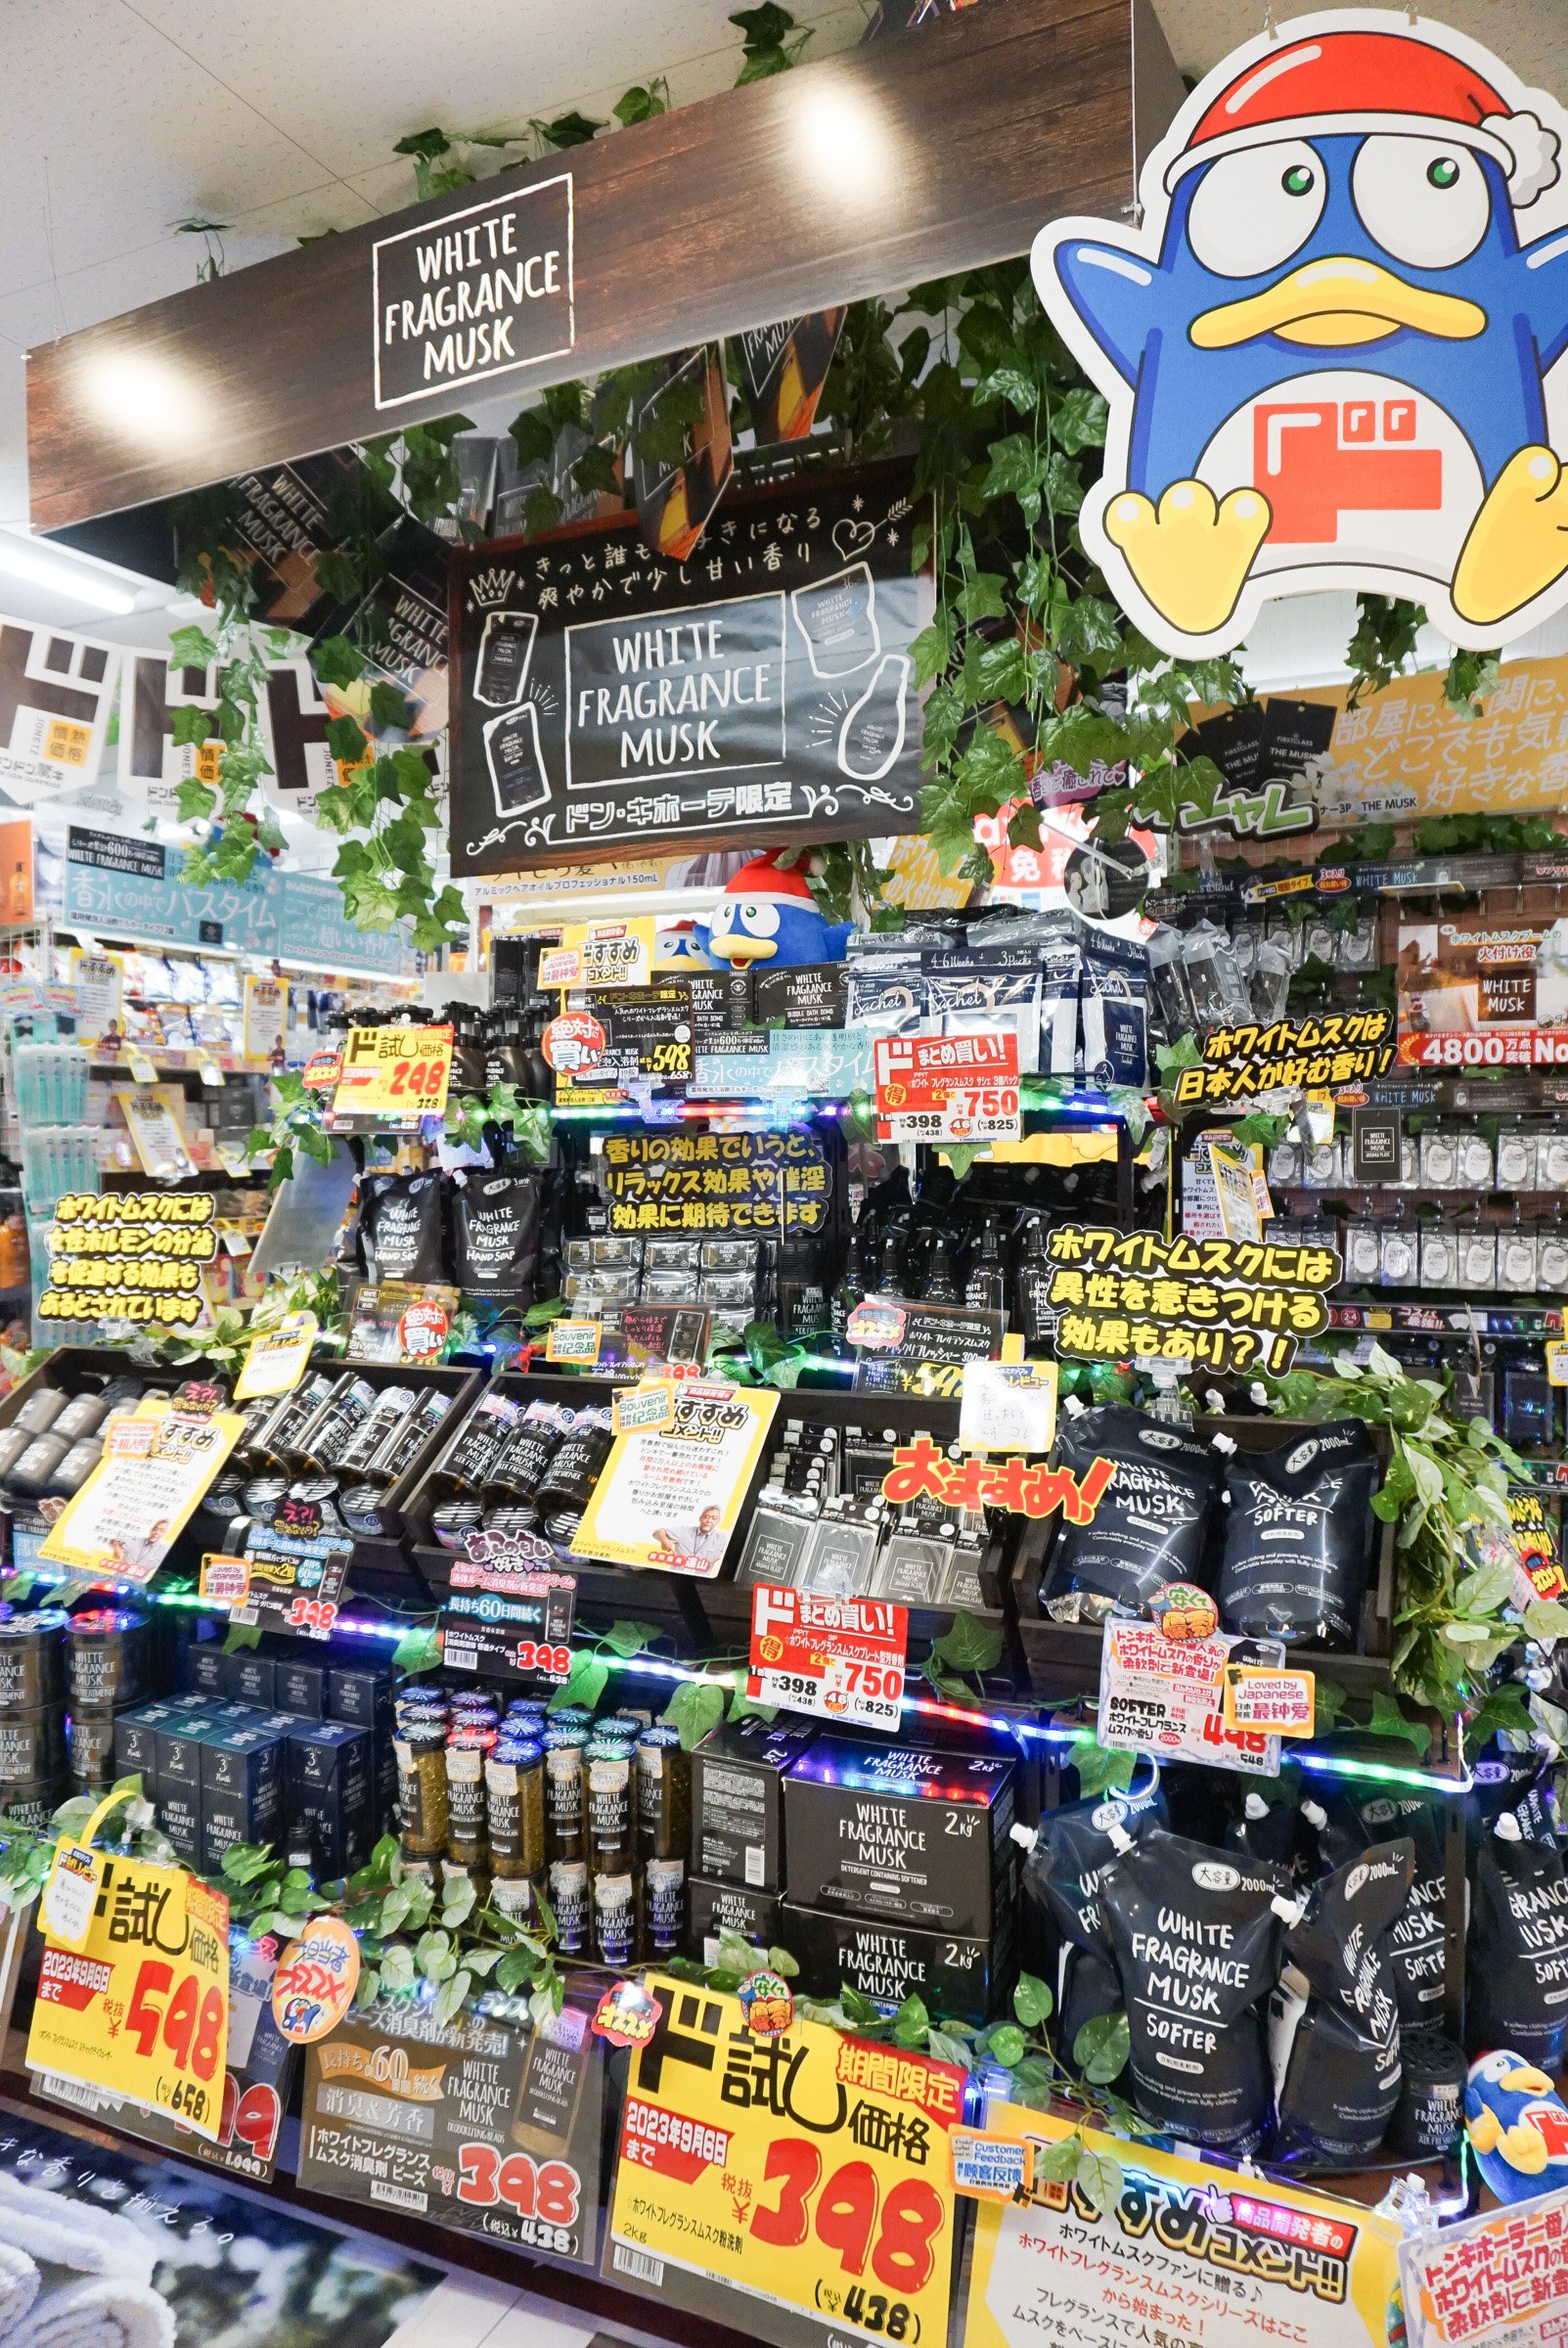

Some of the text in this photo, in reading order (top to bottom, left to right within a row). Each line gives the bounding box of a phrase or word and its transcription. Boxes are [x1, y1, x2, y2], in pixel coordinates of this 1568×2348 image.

[417, 213, 517, 283] WHITE
[385, 250, 560, 344] FRAGRANCE
[424, 316, 515, 380] MUSK
[271, 474, 324, 531] WHITE
[237, 509, 289, 563] MUSK
[538, 543, 810, 609] 爽やかで少し甘い香り
[613, 619, 724, 673] WHITE
[578, 664, 771, 727] FRAGRANCE
[621, 720, 721, 768] MUSK
[565, 782, 792, 834] ドン・キホーテ限定
[1356, 872, 1418, 887] WHITE MUSK
[1450, 928, 1562, 946] ホワイトムスクブームの
[786, 982, 832, 995] FRAGRANCE
[795, 972, 822, 983] WHITE
[1482, 978, 1531, 994] WHITE
[797, 993, 823, 1005] MUSK
[854, 989, 901, 1016] Sachet
[930, 988, 982, 1013] Sachet
[1488, 997, 1525, 1012] MUSK
[1207, 1014, 1386, 1059] ホワイトムスクは
[652, 1044, 691, 1072] 598
[918, 1034, 1007, 1066] まとめ買い!
[1422, 1038, 1504, 1064] 4800
[389, 1061, 447, 1096] 298
[1179, 1048, 1396, 1102] 日本人が好む香り!
[963, 1090, 1018, 1116] 750
[605, 1133, 817, 1164] 香りの効果でいうと、
[606, 1166, 826, 1196] リラックス効果や催淫
[57, 1196, 212, 1222] ホワイトムスクには
[476, 1206, 514, 1221] WHITE
[612, 1202, 822, 1230] 効果に期待できます
[469, 1219, 520, 1236] FRAGRANCE
[49, 1226, 214, 1256] 女性ホルモンの分泌
[476, 1236, 509, 1246] MUSK
[1051, 1229, 1332, 1282] ホワイトムスクには
[50, 1259, 199, 1288] を促進する効果も
[40, 1290, 202, 1323] あるとされています
[1051, 1271, 1321, 1330] 異性を惹きつける
[554, 1332, 596, 1342] Souvenir
[619, 1394, 667, 1412] Souvenir
[507, 1444, 548, 1468] FRAGRANCE
[518, 1437, 545, 1454] WHITE
[560, 1443, 585, 1453] WHITE
[510, 1454, 537, 1469] MUSK
[628, 1480, 711, 1497] ホワイトフレグランスムスクの
[882, 1436, 1115, 1526] おすすめ!
[631, 1498, 695, 1513] 包み込み至福の時間
[632, 1489, 700, 1505] 香りがお部屋をやさしく
[1115, 1494, 1185, 1515] MUSK
[641, 1508, 679, 1518] へと誘います
[1254, 1507, 1319, 1526] SOFTER
[291, 1598, 337, 1631] 398
[449, 1597, 541, 1622] 長持ち60日間続く
[800, 1603, 894, 1635] まとめ買い!
[75, 1651, 104, 1665] WHITE
[517, 1641, 571, 1675] 398
[75, 1674, 105, 1687] MUSK
[844, 1661, 903, 1701] 750
[1248, 1681, 1297, 1692] Loved by
[1110, 1695, 1166, 1718] SOFTER
[1238, 1690, 1304, 1700] Japanese
[1108, 1713, 1187, 1733] ホワイトフレグランス
[1253, 1703, 1310, 1721] 最钟爱
[1108, 1725, 1153, 1740] ムスクの香り
[864, 1756, 943, 1776] FRAGRANCE
[887, 1750, 932, 1764] WHITE
[447, 1792, 483, 1804] FRAGRANCE
[452, 1783, 475, 1792] WHITE
[596, 1793, 619, 1804] WHITE
[168, 1801, 188, 1815] WHITE
[589, 1802, 628, 1815] FRAGRANCE
[597, 1814, 619, 1826] MUSK
[856, 1803, 907, 1829] WHITE
[161, 1813, 195, 1830] FRAGRANCE
[169, 1825, 188, 1838] MUSK
[839, 1820, 927, 1852] FRAGRANCE
[859, 1843, 907, 1870] MUSK
[840, 1865, 927, 1886] DETERGENT CONTAINING SOFTENER
[1198, 1866, 1234, 1887] 大容量
[712, 1902, 756, 1920] FRAGRANCE
[721, 1893, 746, 1908] WHITE
[722, 1915, 746, 1930] MUSK
[1158, 1907, 1234, 1950] WHITE
[856, 1932, 907, 1959] WHITE
[838, 1949, 926, 1982] FRAGRANCE
[1132, 1932, 1250, 1989] FRAGRANCE
[40, 1981, 62, 2002] まで
[858, 1972, 906, 2000] MUSK
[1147, 1971, 1221, 2015] MUSK
[125, 1961, 224, 2082] 598
[1146, 2013, 1217, 2054] SOFTER
[463, 2059, 499, 2085] WHITE
[721, 2028, 848, 2134] 試し
[837, 2043, 961, 2115] 期間限定
[447, 2077, 511, 2108] FRAGRANCE
[460, 2100, 494, 2127] MUSK
[626, 2101, 728, 2168] 2023年9月6日
[848, 2100, 930, 2165] 価格
[1427, 2122, 1456, 2135] MUSK
[318, 2128, 431, 2170] ホワイトフレグランス
[626, 2138, 655, 2167] まで
[974, 2143, 1025, 2156] Customer
[974, 2153, 1026, 2165] Feedback
[316, 2147, 426, 2187] ムスク消臭剤 ビーズ
[457, 2143, 581, 2228] 398
[721, 2172, 752, 2199] 税抜
[749, 2137, 945, 2296] 398
[1236, 2201, 1345, 2250] 商品開発者の
[1210, 2227, 1347, 2304] コメント!!
[1018, 2233, 1308, 2344] ホワイトフレグランスムスクシリーズはここ
[1101, 2286, 1205, 2336] から始まった!
